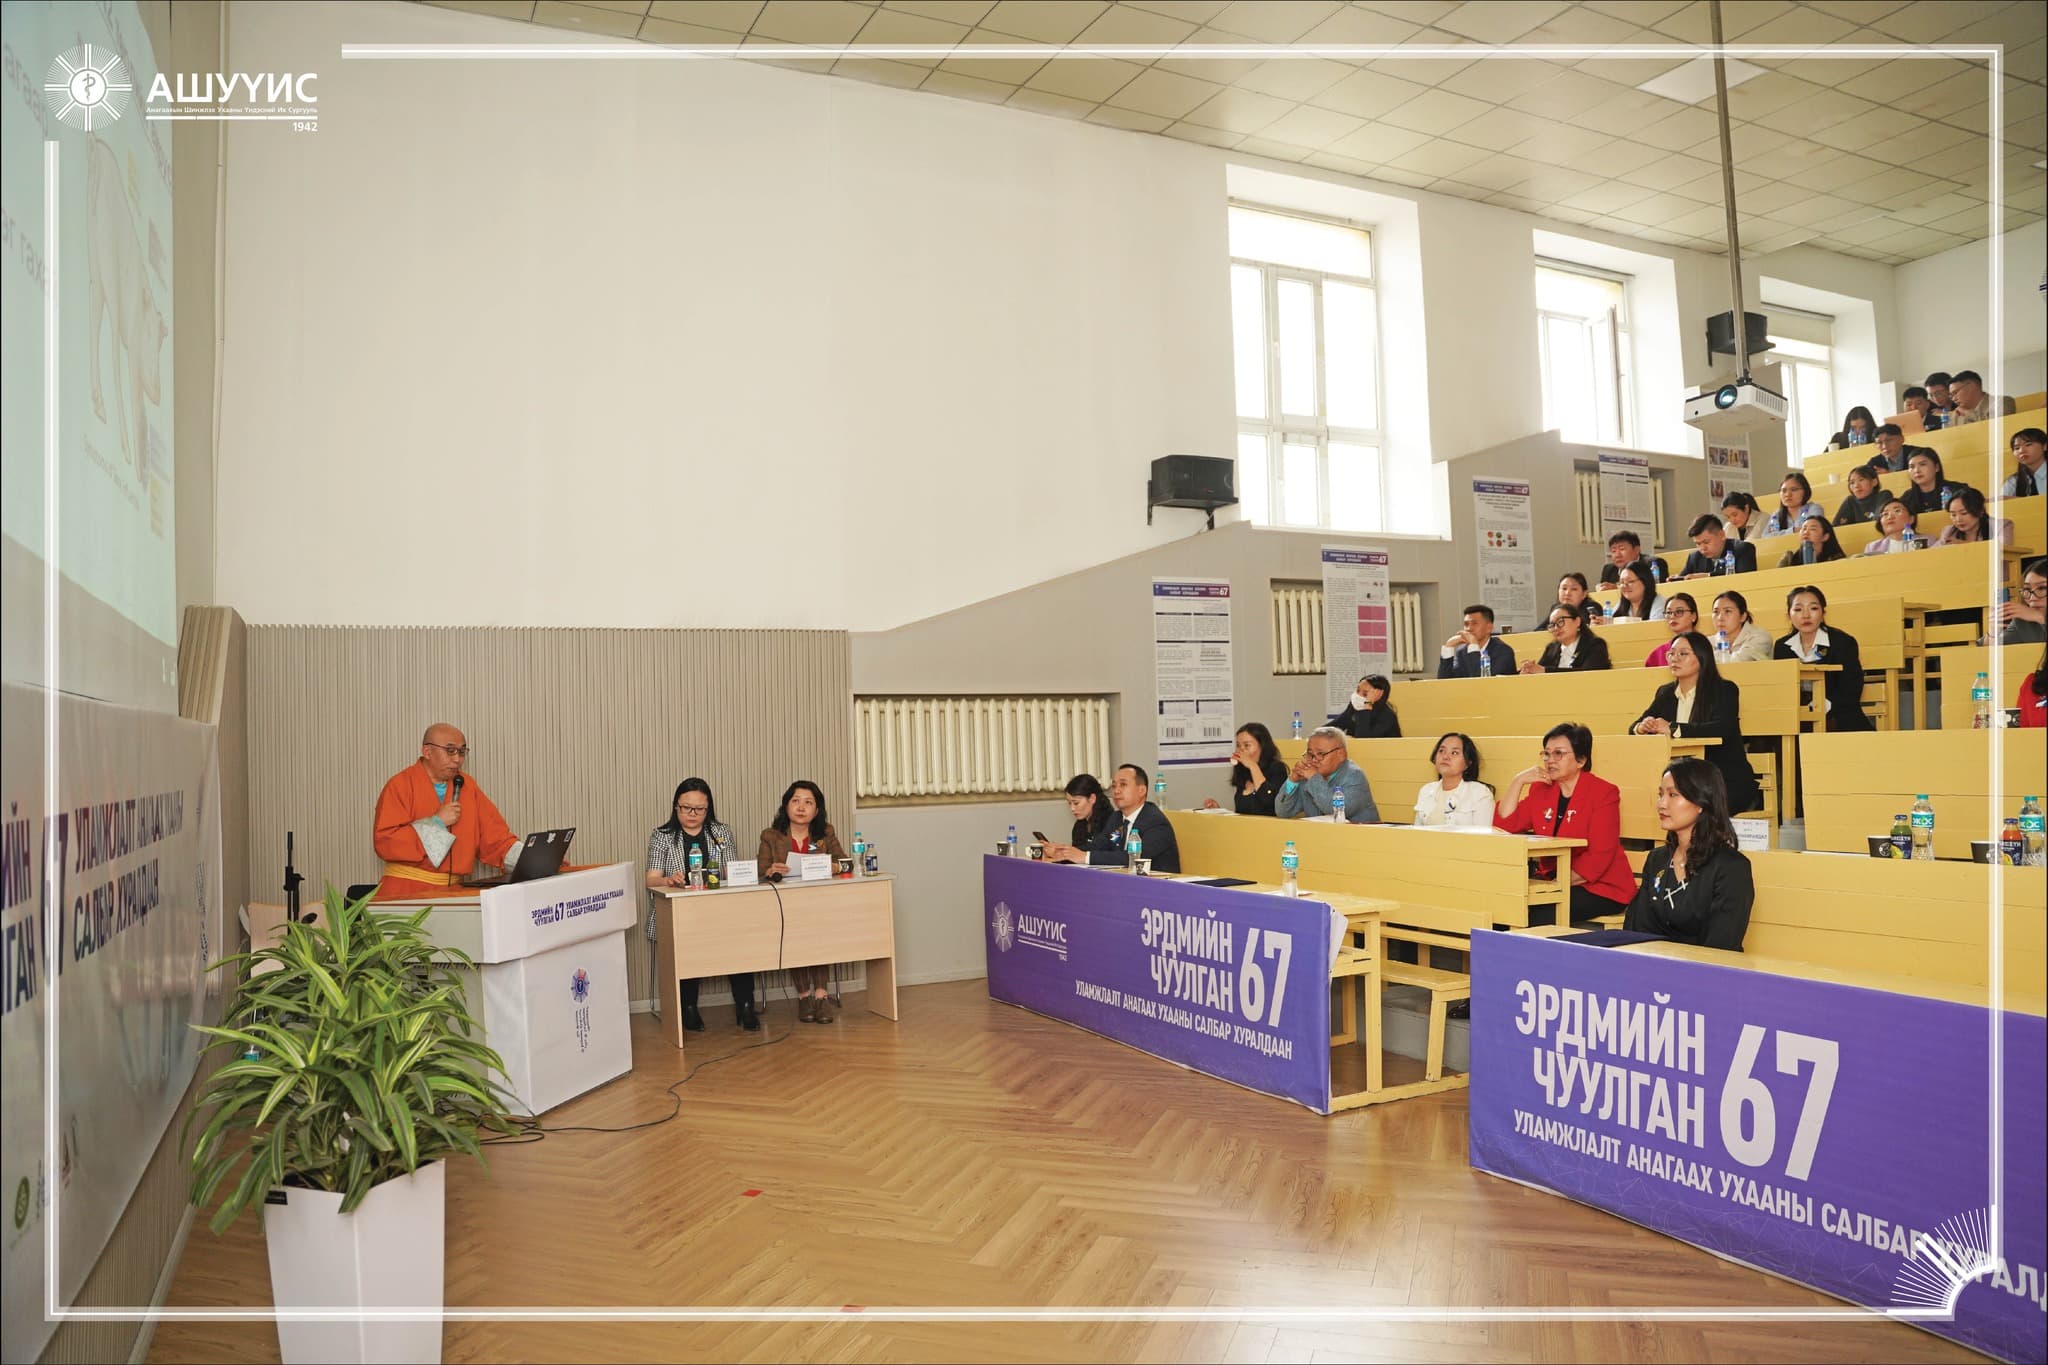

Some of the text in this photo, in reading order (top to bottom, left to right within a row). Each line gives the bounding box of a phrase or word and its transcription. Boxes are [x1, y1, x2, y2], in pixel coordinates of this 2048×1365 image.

[554, 902, 564, 922] 67
[1141, 907, 1233, 964] ЭРДМИЙН
[1076, 979, 1292, 1060] УЛАМЖЛАЛТ АНАГААХ УХААНЫ САЛБАР ХУРАЛДААН
[1151, 954, 1233, 1013] ЧУУЛГАН
[1239, 927, 1292, 1028] 67
[1515, 979, 1705, 1076] ЭРДМИЙН
[1533, 1047, 1705, 1148] ЧУУЛГАН
[1720, 1023, 1839, 1182] 67
[1513, 1108, 1621, 1166] УЛАМЖЛАЛТ
[1626, 1138, 1713, 1194] АНАГААХ
[1719, 1170, 1813, 1226] УХААНЫ
[1821, 1202, 1927, 1261] САЛБАР
